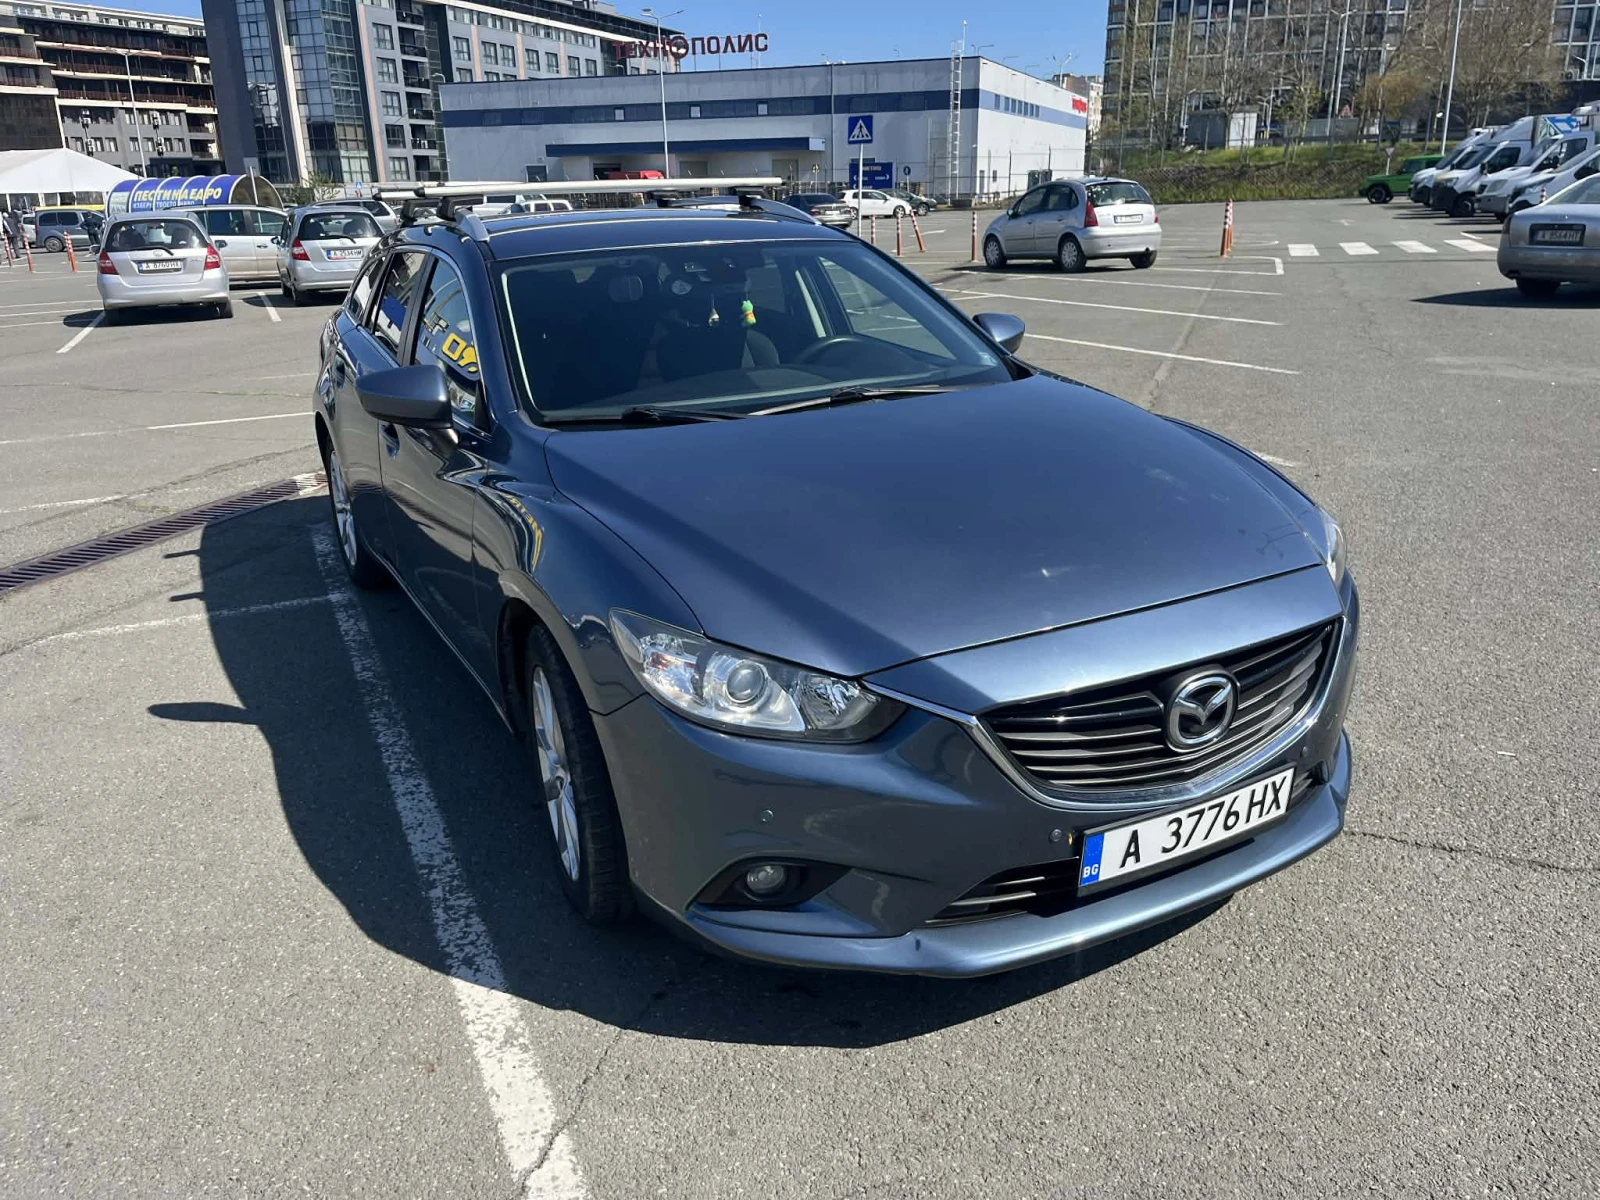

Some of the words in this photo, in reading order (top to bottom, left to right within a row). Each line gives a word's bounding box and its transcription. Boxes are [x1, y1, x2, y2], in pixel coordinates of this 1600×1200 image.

[612, 33, 768, 60] ТЕХНОПОЛИС
[1118, 829, 1141, 869] A
[1082, 863, 1099, 879] BG
